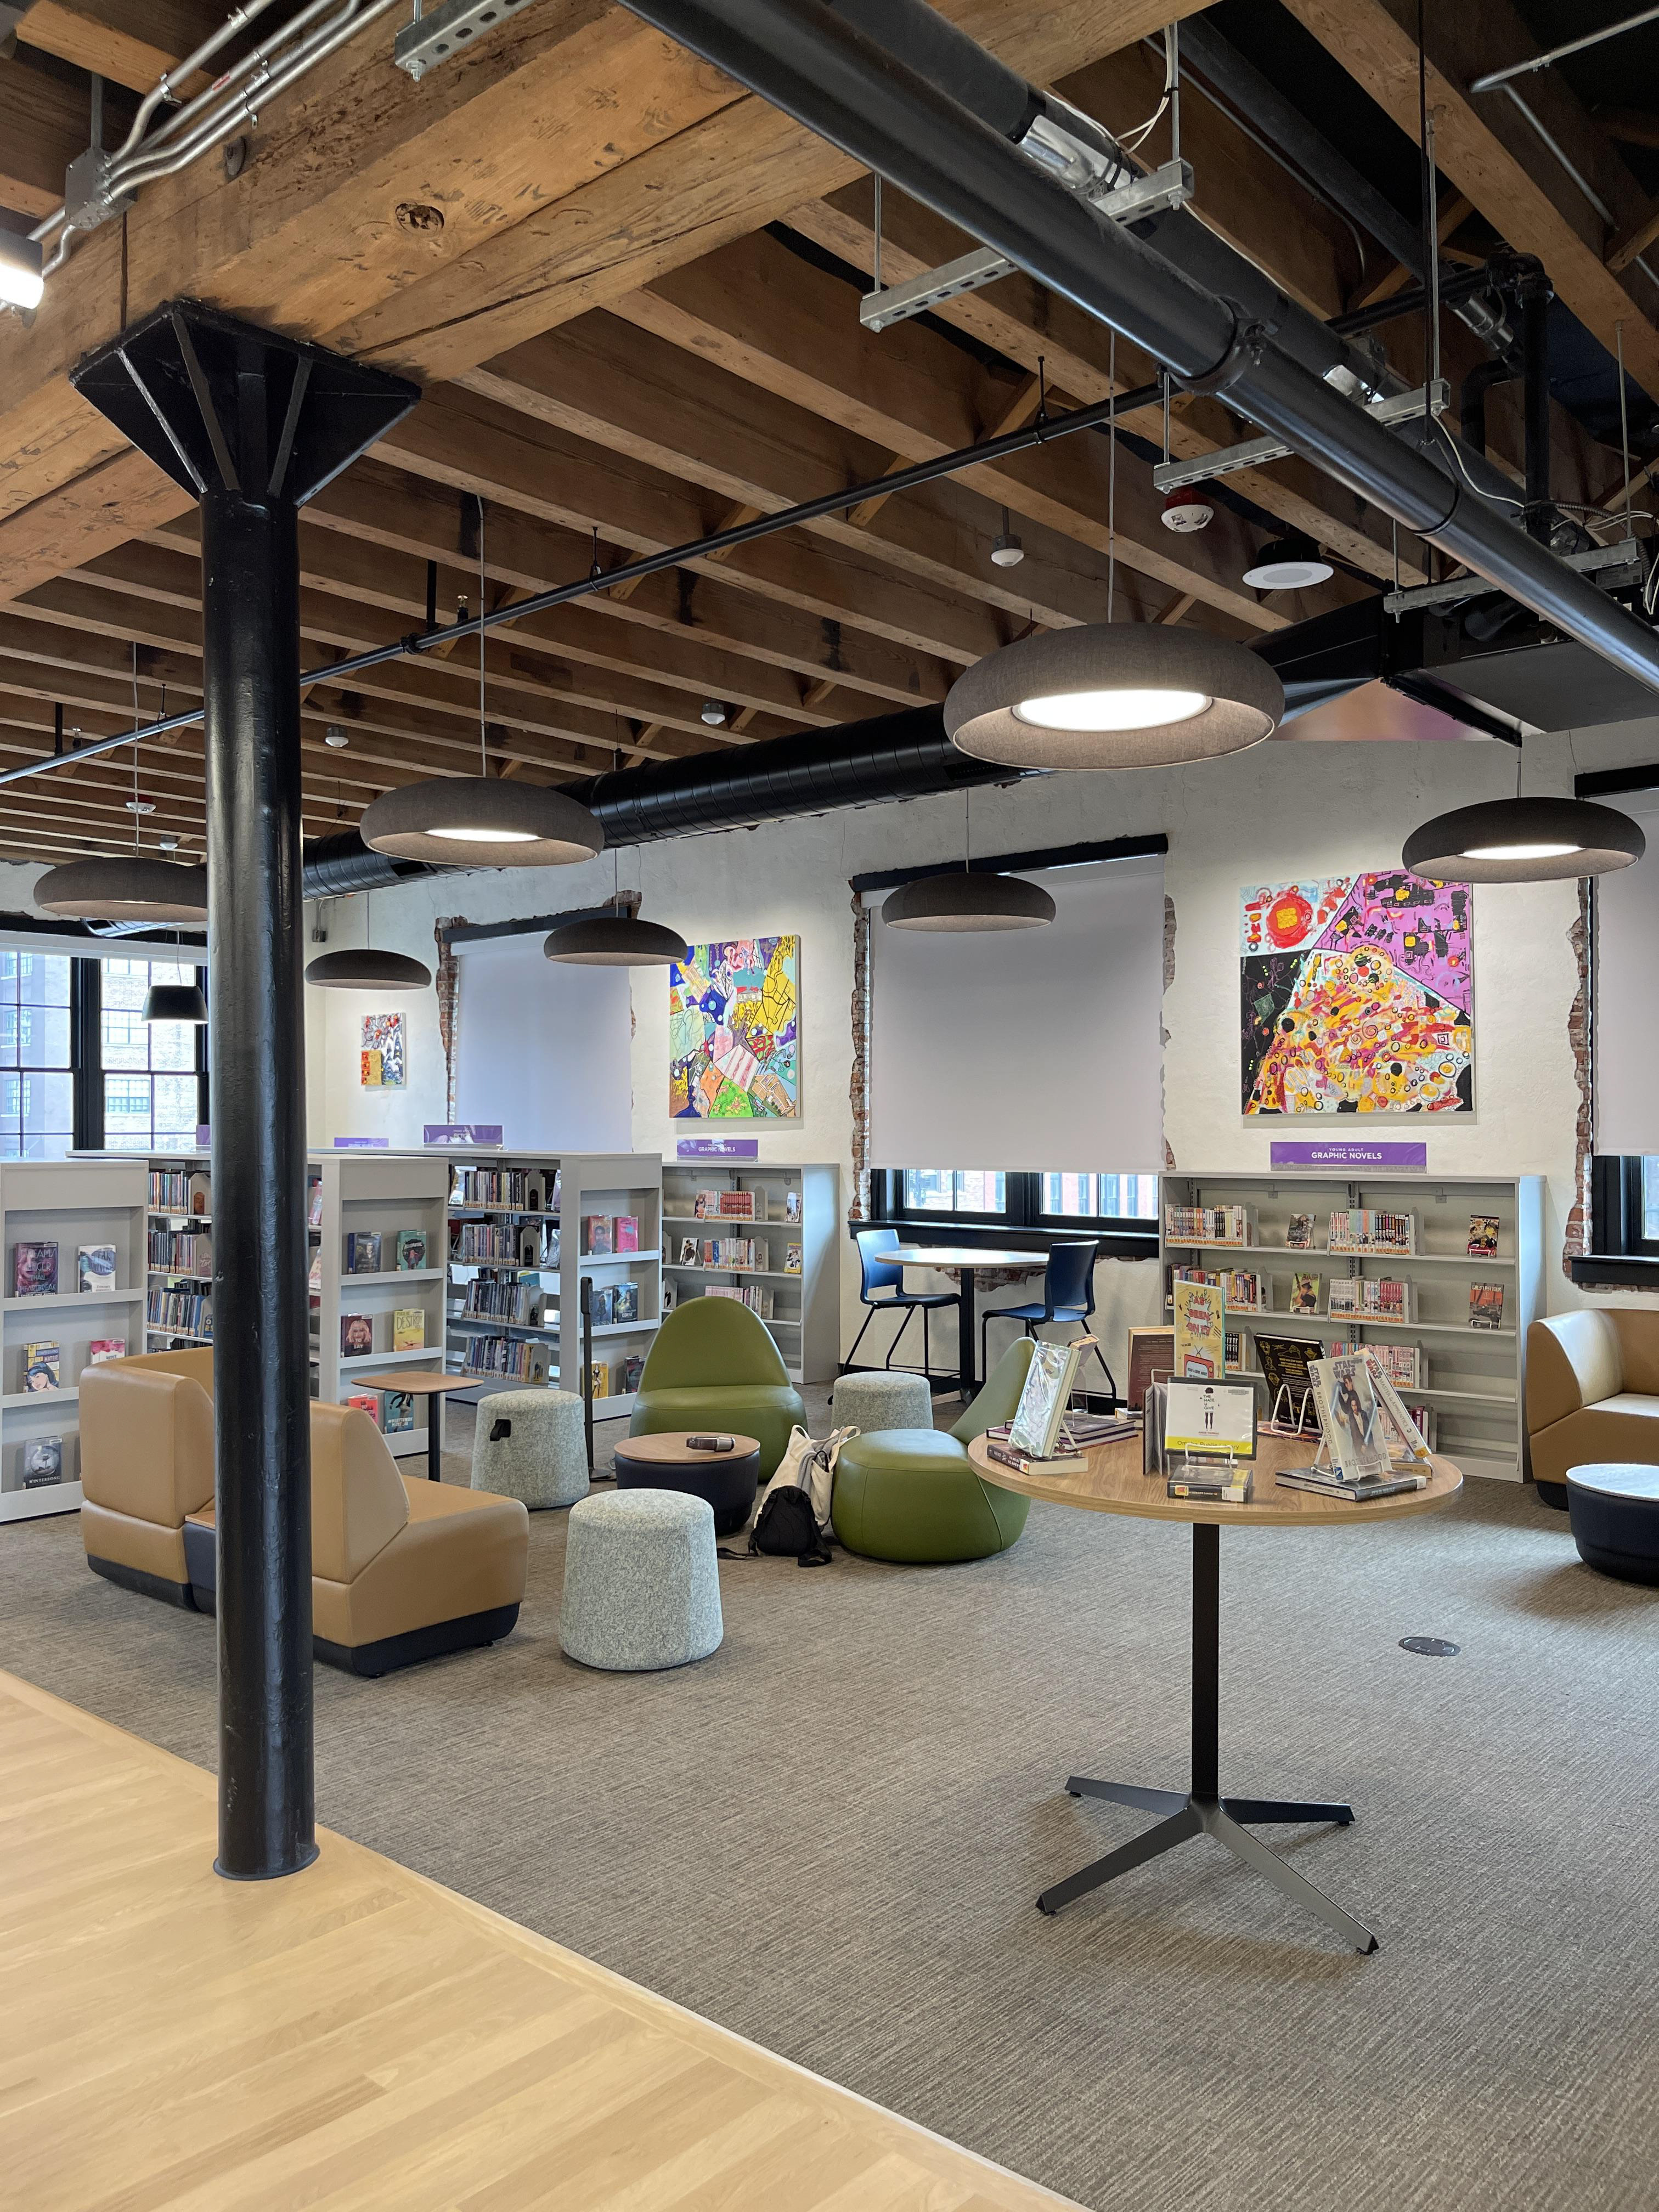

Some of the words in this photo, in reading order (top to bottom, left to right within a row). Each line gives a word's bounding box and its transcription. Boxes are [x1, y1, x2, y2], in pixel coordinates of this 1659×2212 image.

[1193, 1295, 1205, 1306] AS
[397, 1315, 422, 1330] DESTROY
[1333, 1360, 1355, 1370] STAR
[1369, 1358, 1383, 1379] STAR
[1333, 1368, 1356, 1379] WARS
[1379, 1379, 1391, 1396] MASTER
[1317, 1391, 1333, 1444] BROTHERHOOD
[1345, 1453, 1387, 1468] BROTHERHOOD
